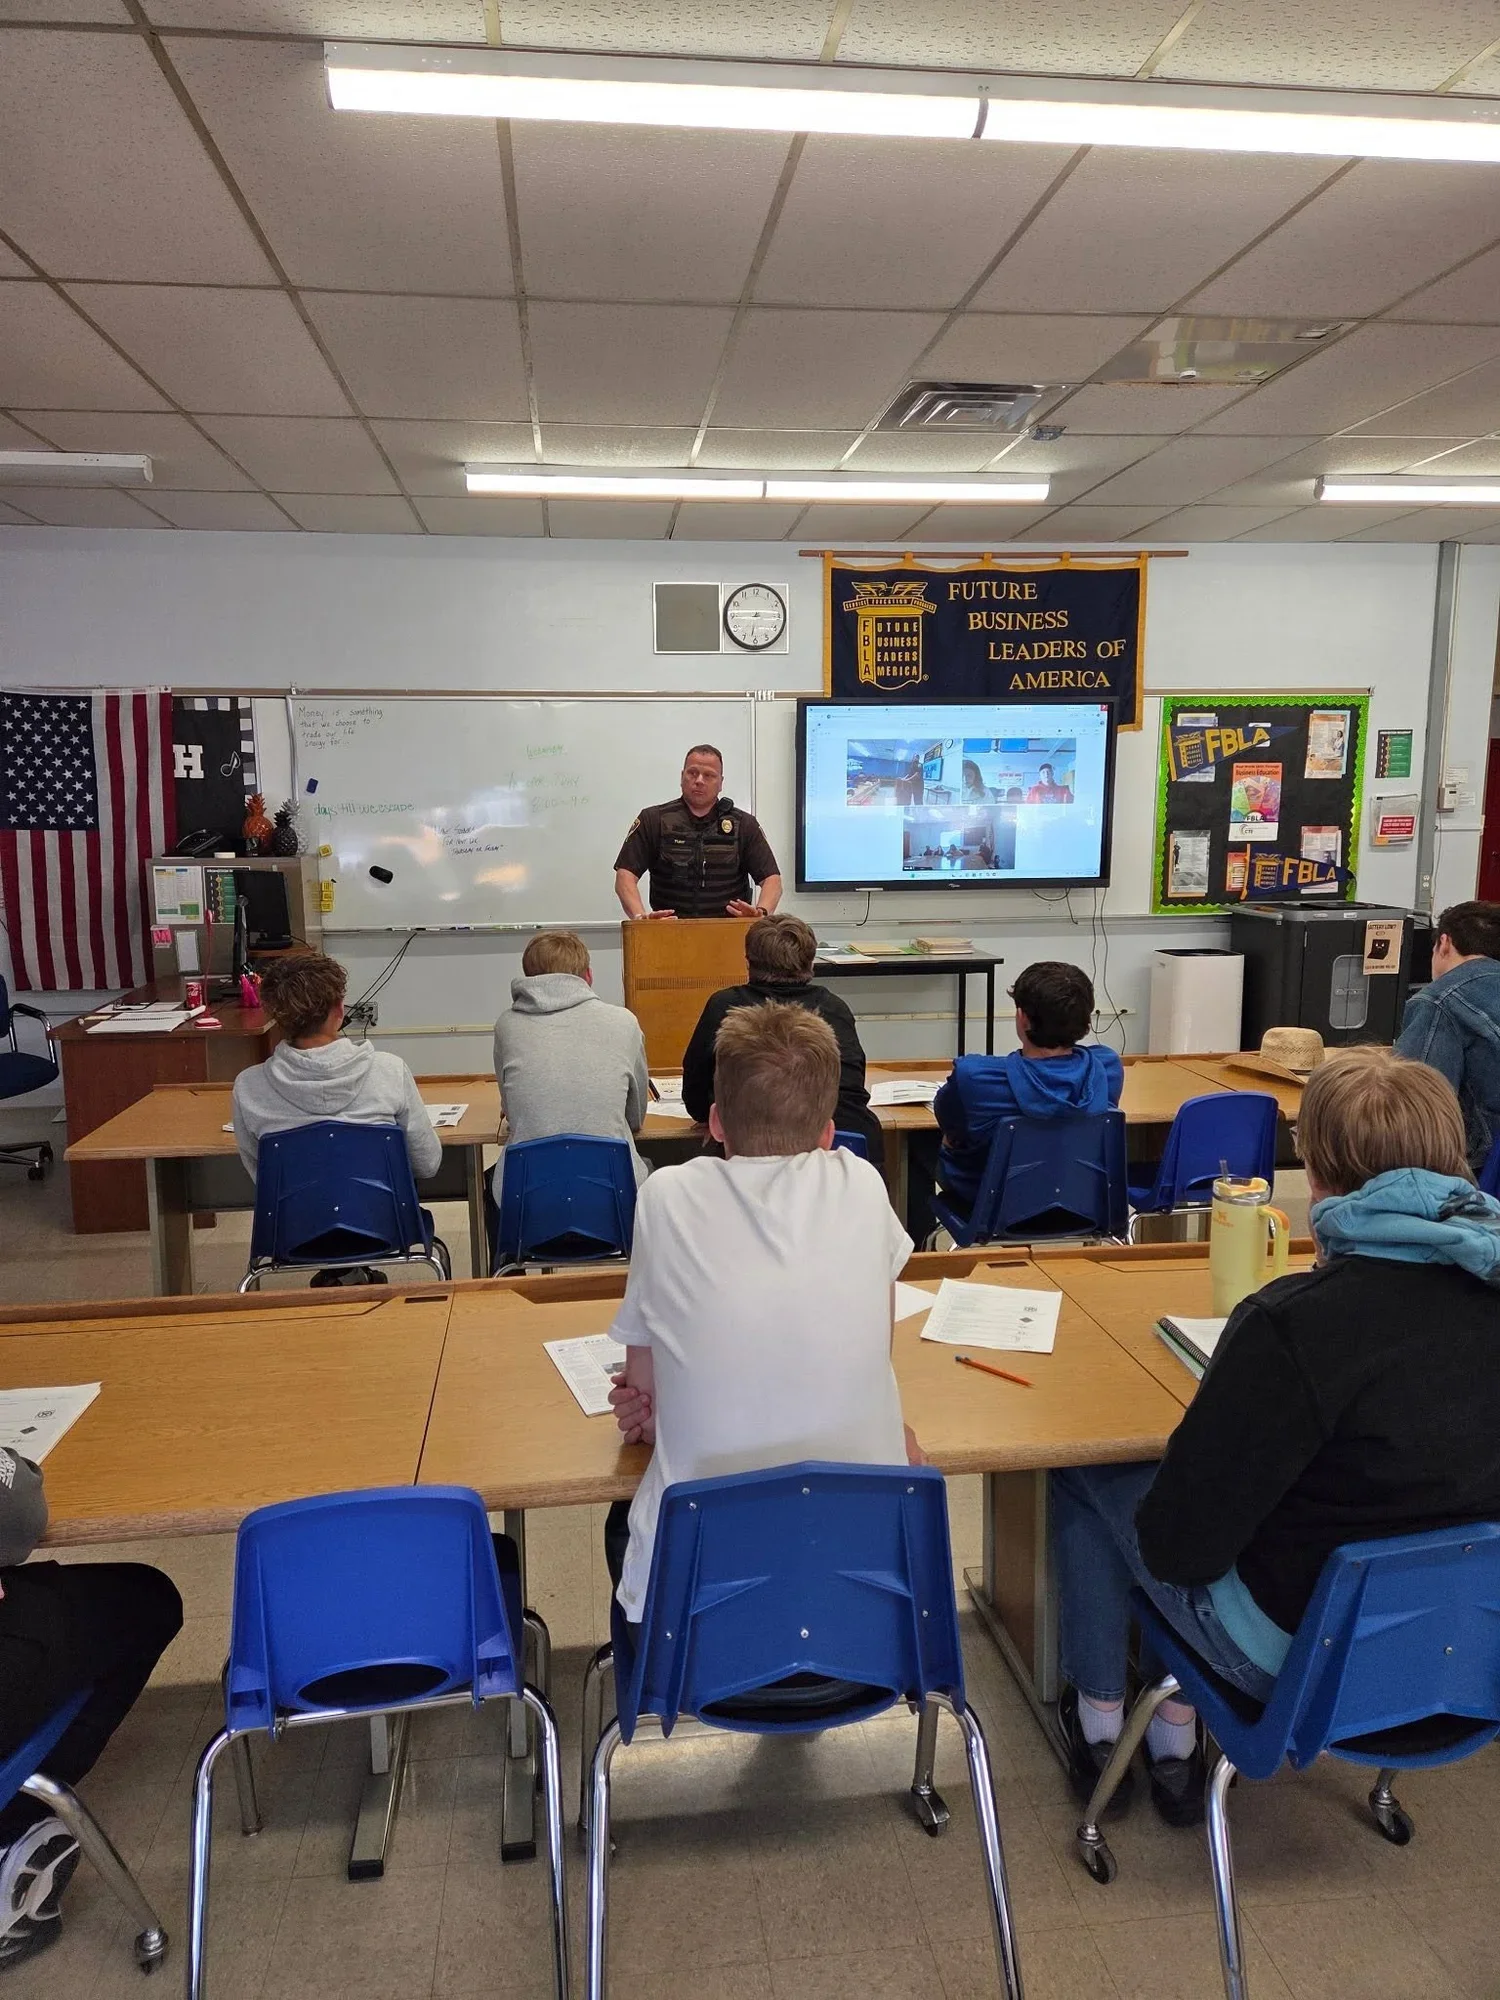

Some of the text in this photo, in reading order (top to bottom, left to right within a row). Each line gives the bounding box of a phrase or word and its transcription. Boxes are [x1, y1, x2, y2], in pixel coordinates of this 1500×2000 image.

[741, 591, 747, 599] 11
[752, 588, 760, 596] 12
[948, 581, 1038, 601] FUTURE
[968, 610, 1069, 630] BUSINESS
[989, 639, 1127, 660] LEADERS OF
[1009, 670, 1111, 690] AMERICA
[299, 705, 325, 720] Money
[349, 706, 384, 719] something
[1205, 728, 1271, 763] FBLA
[172, 744, 204, 779] H
[314, 803, 338, 821] days
[341, 802, 356, 815] till
[1282, 857, 1336, 886] FBLA
